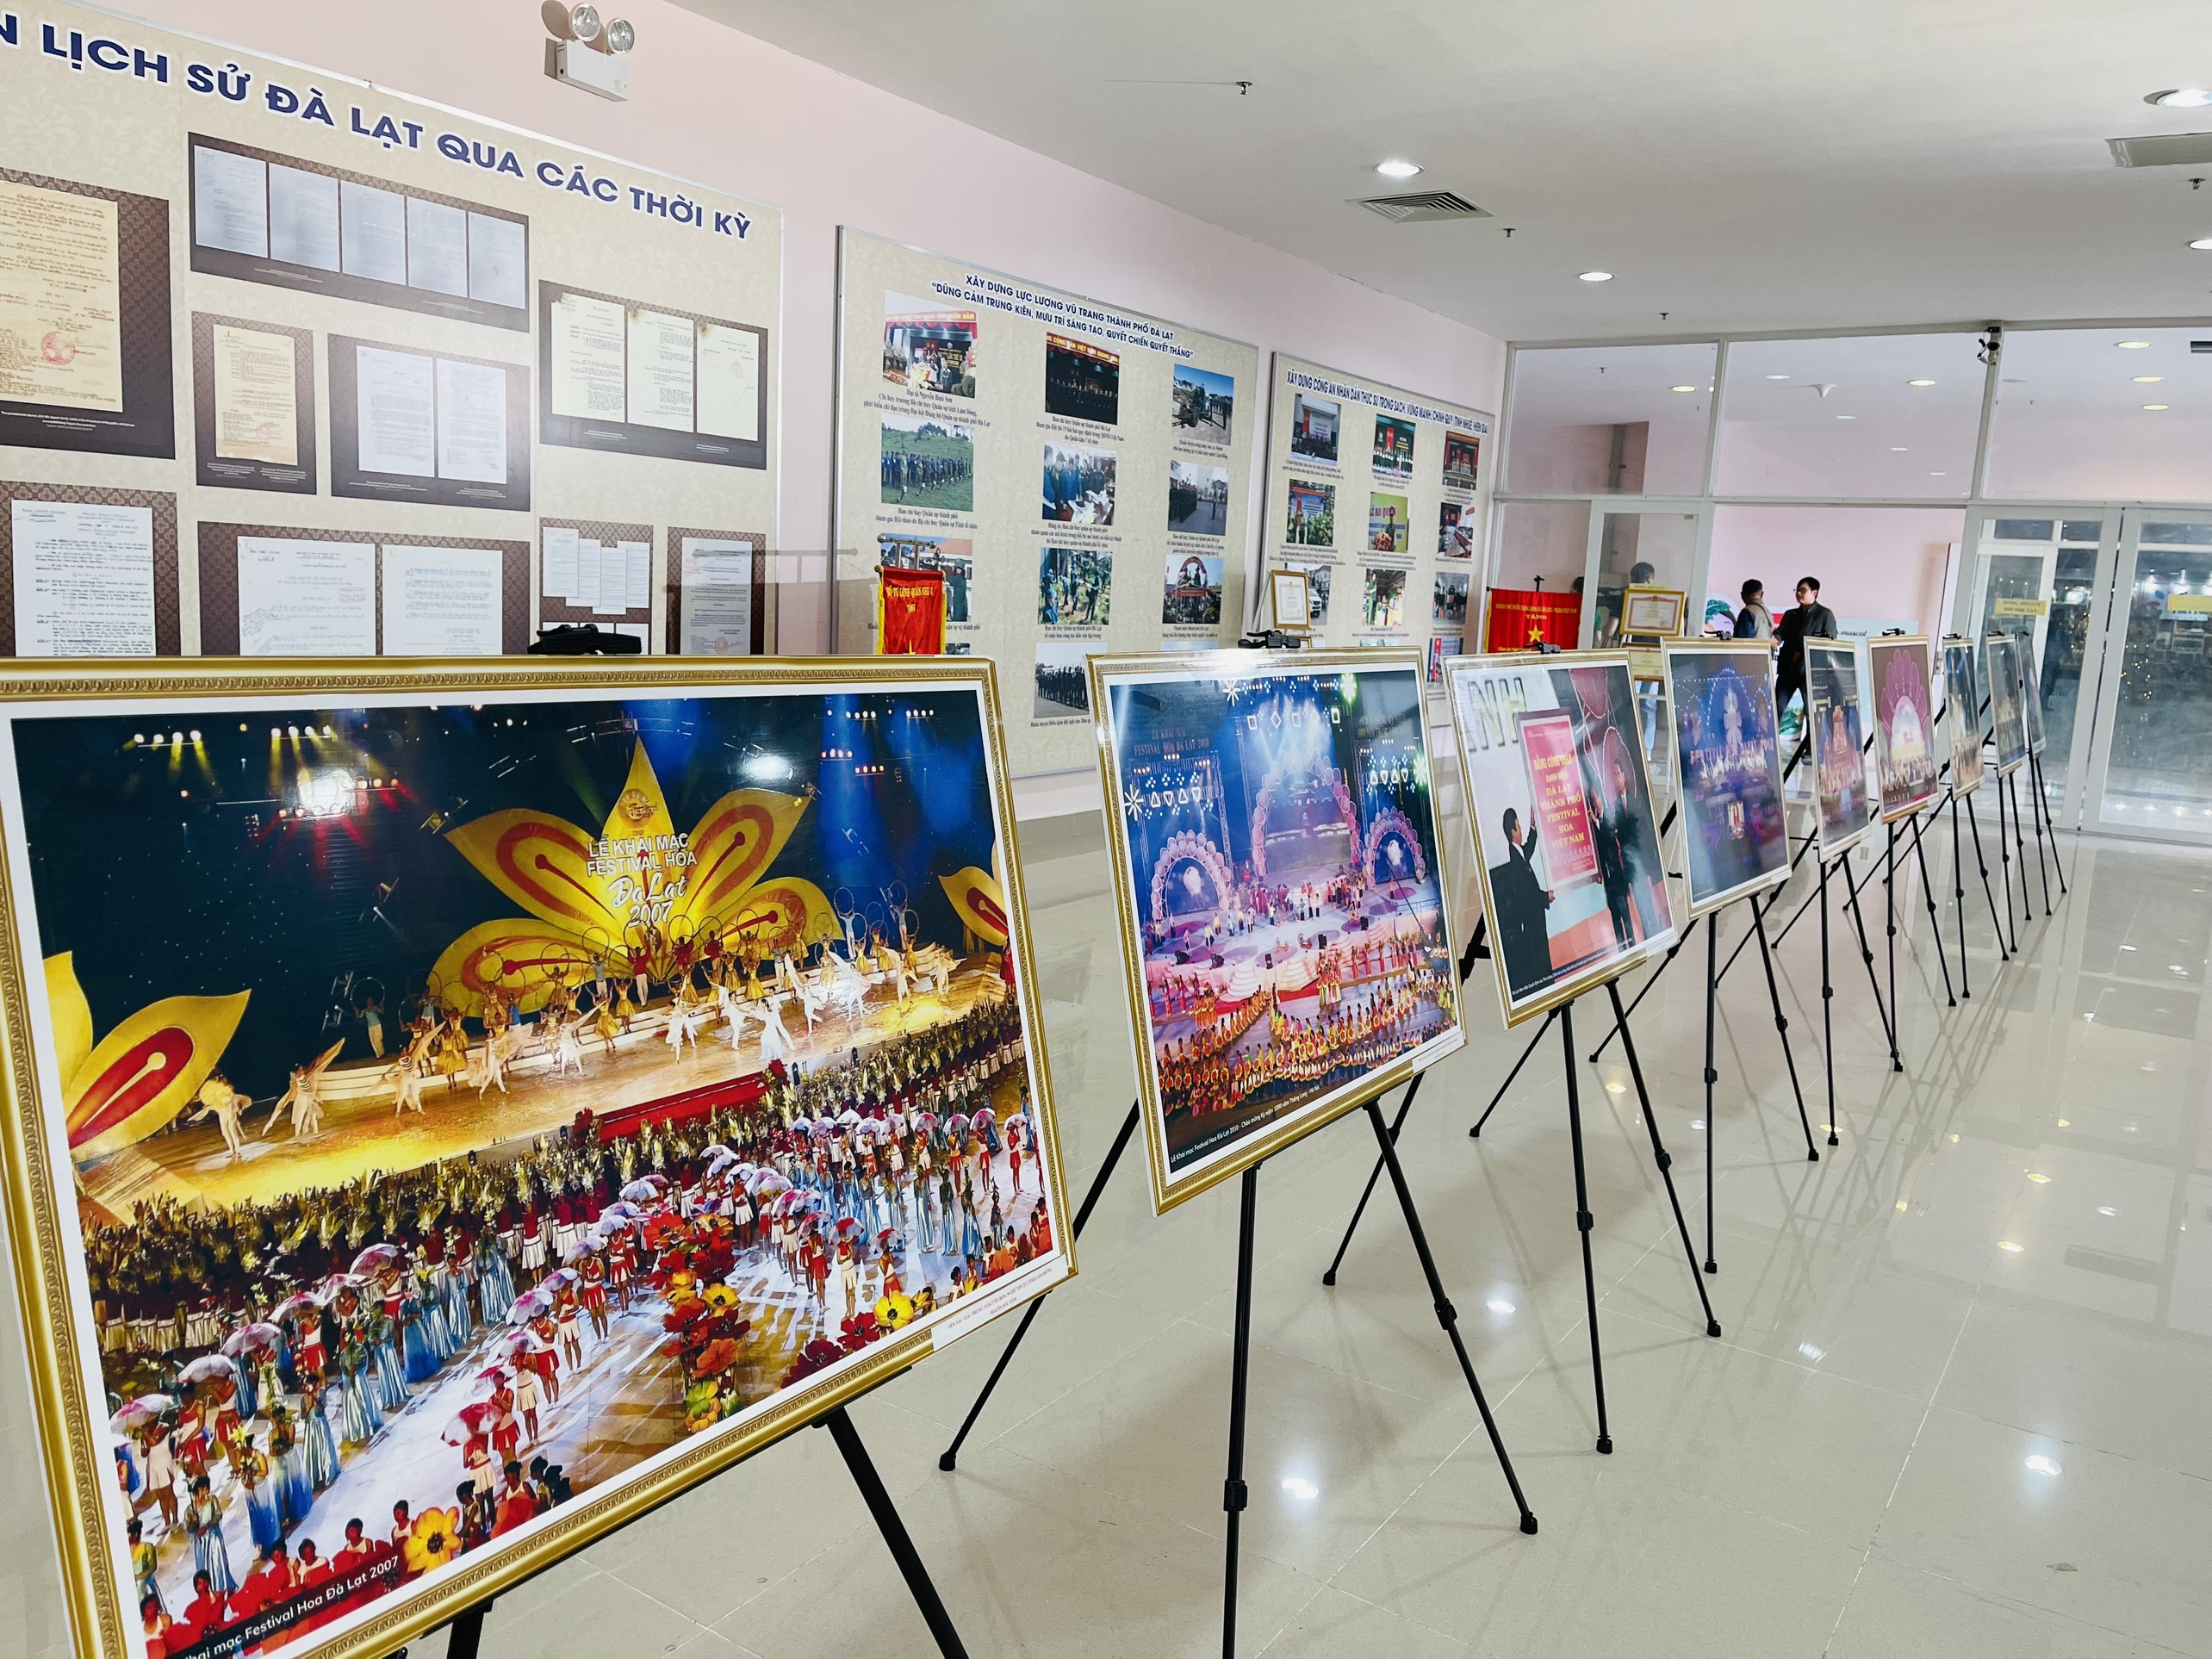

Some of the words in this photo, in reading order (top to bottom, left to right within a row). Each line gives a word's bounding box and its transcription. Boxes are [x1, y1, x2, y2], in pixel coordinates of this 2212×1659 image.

[42, 23, 169, 84] LỊCH
[187, 63, 251, 102] SỬ
[265, 84, 335, 127] ĐÀ
[351, 107, 423, 149] LẠT
[437, 134, 525, 179] QUA
[536, 162, 618, 202] CÁC
[629, 187, 702, 228] THỜI
[714, 211, 751, 239] KỲ
[966, 275, 985, 289] XÂY
[987, 281, 1013, 295] DỰNG
[1016, 289, 1033, 302] LỰC
[1035, 295, 1063, 310] LƯỢNG
[1066, 303, 1077, 314] VŨ
[1078, 308, 1104, 321] TRANG
[1106, 315, 1131, 329] THÀNH
[1133, 322, 1149, 333] PHỐ
[1150, 326, 1160, 337] ĐÀ
[1162, 331, 1173, 341] LẠT
[964, 290, 984, 303] CẢM
[985, 296, 1013, 311] TRUNG
[1035, 311, 1053, 322] MƯU
[1054, 315, 1065, 326] TRÍ
[1066, 319, 1087, 332] SÁNG
[1106, 330, 1127, 342] QUYẾT
[1128, 334, 1149, 348] CHIẾN
[1149, 340, 1169, 353] QUYẾT
[1567, 790, 1581, 805] PHỐ
[1547, 807, 1580, 823] FESTIVAL
[1558, 823, 1574, 834] HOA
[1569, 832, 1585, 844] NAM
[587, 834, 610, 858] LỄ
[612, 836, 654, 855] KHAI
[656, 832, 689, 854] MẠC
[586, 855, 662, 877] FESTIVAL
[627, 899, 674, 928] 2007
[214, 1635, 242, 1656] mạc
[245, 1609, 294, 1638] Festival
[296, 1595, 323, 1616] Hoa
[326, 1584, 344, 1600] Đà
[347, 1573, 367, 1592] Lạt
[370, 1556, 400, 1579] 2007
